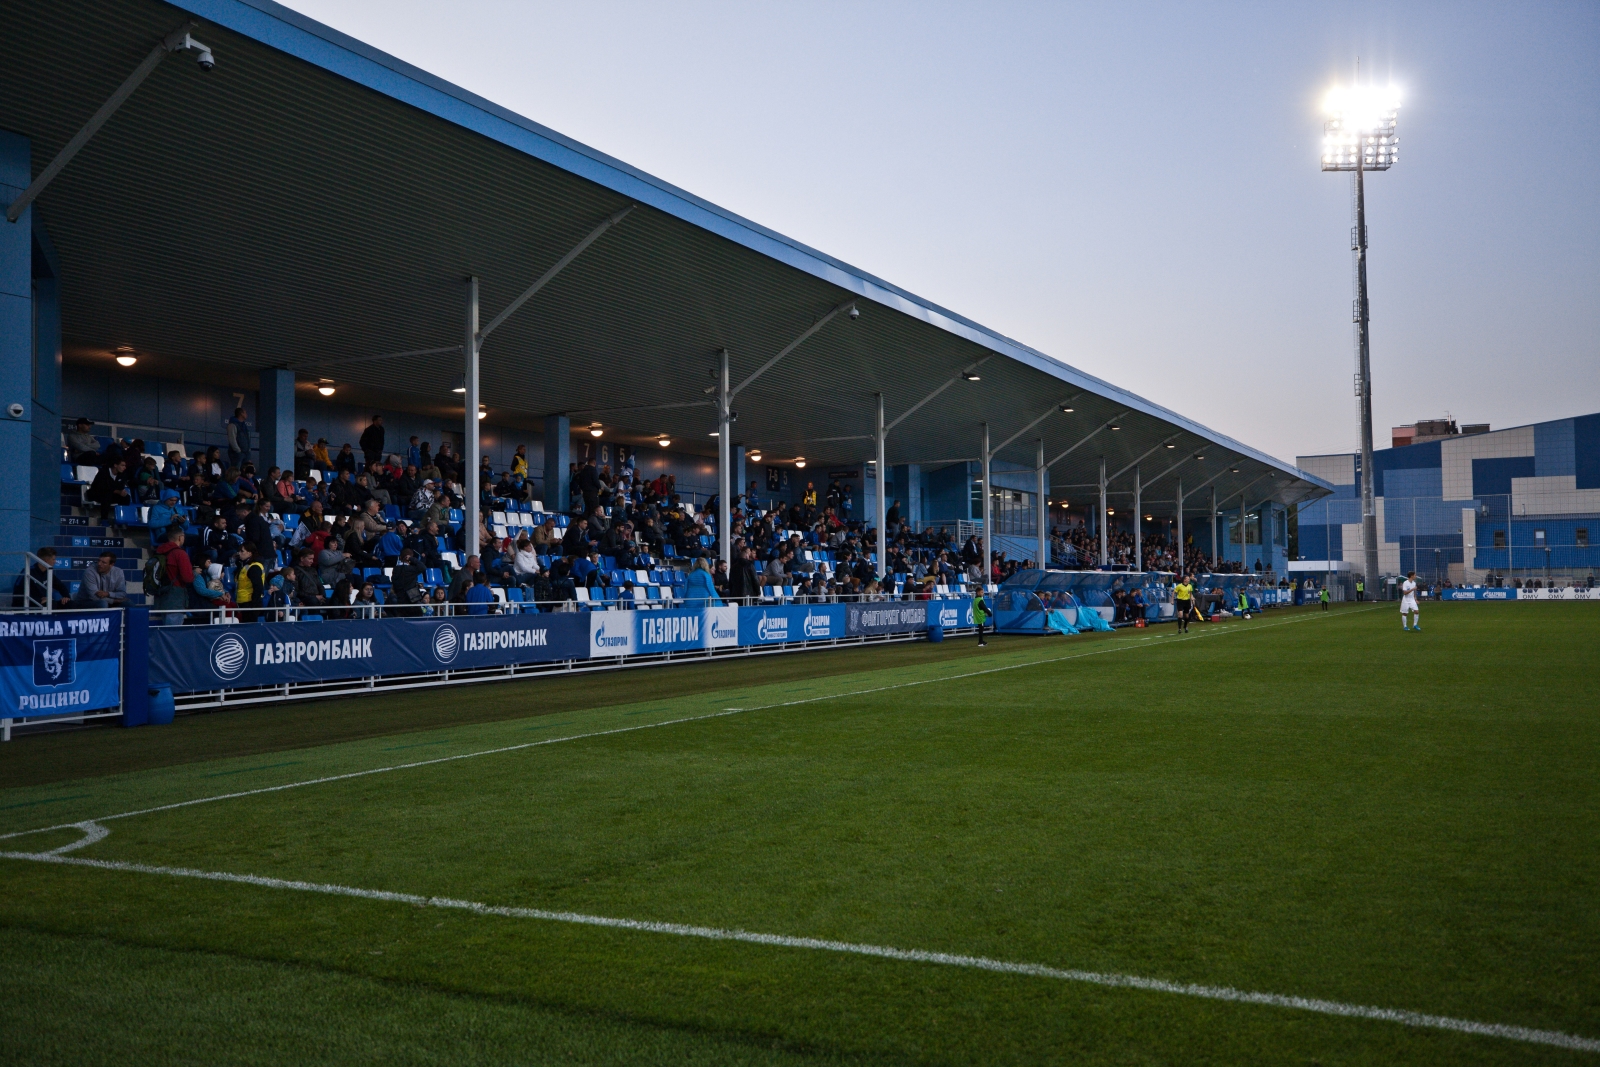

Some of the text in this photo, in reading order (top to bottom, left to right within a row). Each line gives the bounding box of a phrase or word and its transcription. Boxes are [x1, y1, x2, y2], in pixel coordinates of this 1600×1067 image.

[583, 442, 590, 458] 7
[601, 445, 609, 463] 6
[619, 447, 626, 463] 5
[67, 617, 110, 635] TOWN
[642, 616, 699, 645] ГАЗПРОМ
[463, 628, 548, 652] ГАЗПРОМБАНК
[605, 636, 628, 647] ГАЗПРОМ
[255, 637, 373, 666] ГАЗПРОМБАНК
[18, 689, 90, 711] РОЩИНО
